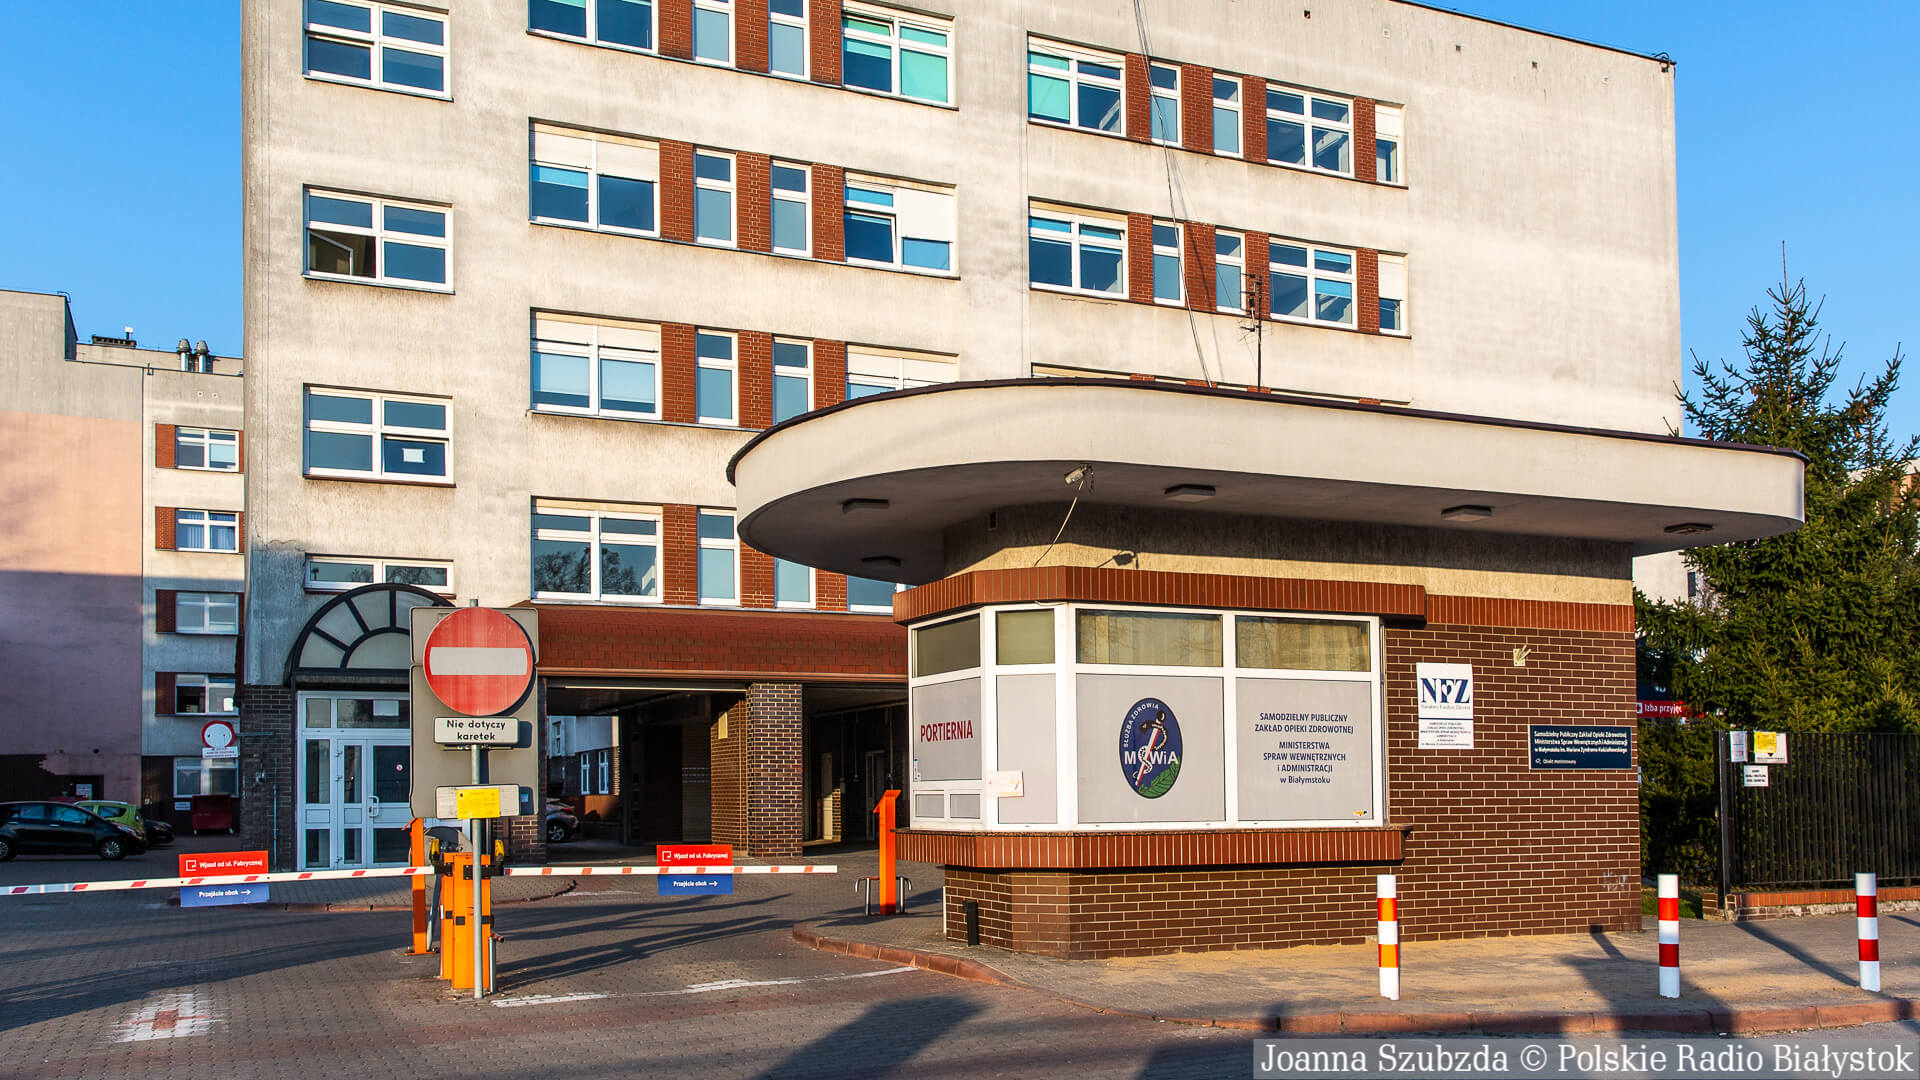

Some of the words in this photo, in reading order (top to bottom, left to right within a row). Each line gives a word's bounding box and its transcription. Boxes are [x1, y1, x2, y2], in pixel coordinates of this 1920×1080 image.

[1420, 678, 1470, 704] NFZ
[1131, 702, 1160, 720] ZDROWIA
[1644, 703, 1658, 712] Izba
[1260, 712, 1309, 721] SAMODZIELNY
[1311, 714, 1348, 722] PUBLICZNY
[447, 720, 464, 728] Nie
[468, 720, 506, 730] dotyczy
[1254, 724, 1282, 732] ZAKŁAD
[1284, 725, 1307, 733] OPIEKI
[1309, 725, 1354, 734] ZDROWOTNEJ
[920, 720, 973, 743] PORTIERNIA
[457, 732, 496, 741] karetek
[1279, 741, 1330, 749] MINISTERSTWA
[1289, 753, 1346, 762] WEWNĘTRZNYCH
[1281, 765, 1333, 773] ADMINISTRACJI
[1288, 776, 1331, 785] Białymstoku
[702, 852, 729, 860] Fabrycznej
[233, 859, 263, 868] Fabrycznej
